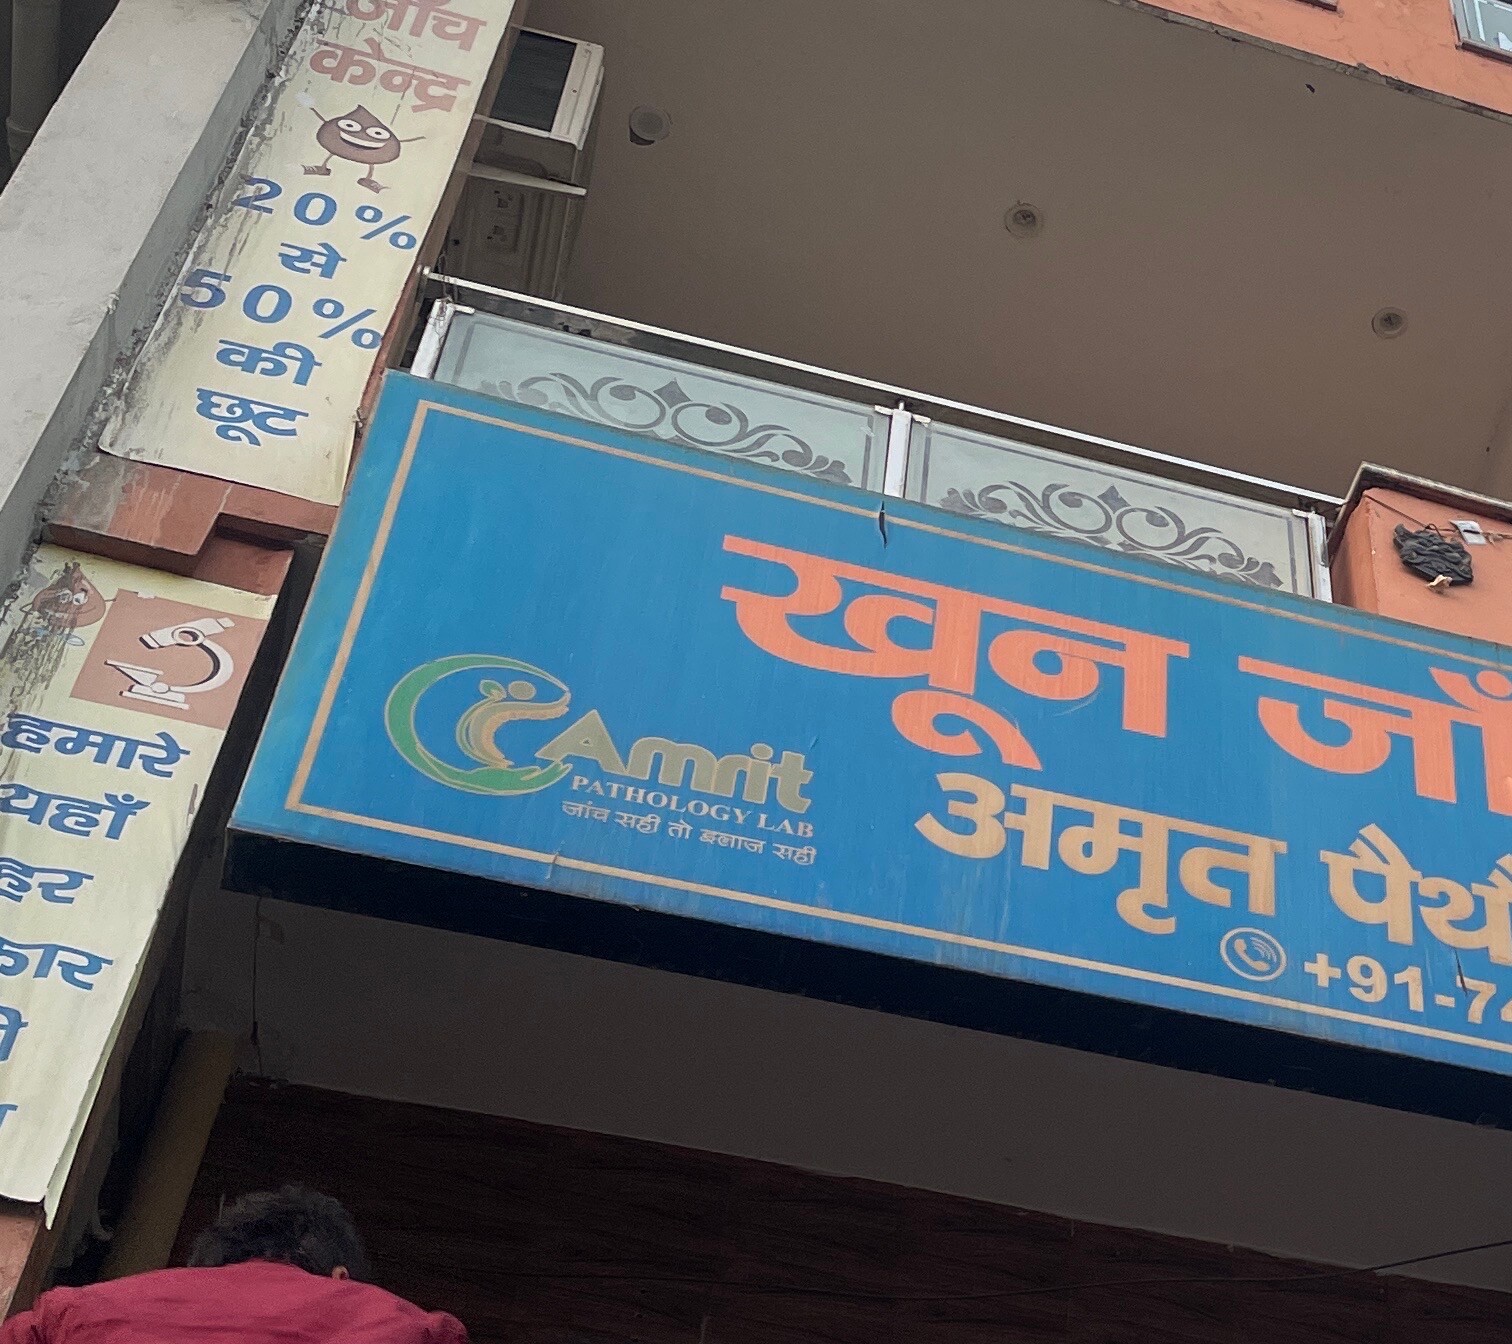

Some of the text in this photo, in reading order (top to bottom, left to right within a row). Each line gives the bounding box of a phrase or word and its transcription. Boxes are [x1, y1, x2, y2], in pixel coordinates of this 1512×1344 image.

[310, 38, 471, 113] केन्द्र
[232, 177, 417, 249] 20%
[278, 242, 347, 279] से
[180, 268, 382, 349] 50%
[216, 339, 322, 386] की
[196, 388, 309, 446] छूट
[722, 534, 1190, 770] खून
[1, 713, 190, 778] हमारे
[535, 709, 813, 814] Amrit
[0, 783, 151, 840] यहाँ
[571, 775, 814, 838] PATHOLOGY LAB
[614, 811, 661, 834] सही
[668, 819, 693, 840] तो
[771, 843, 817, 866] सही
[914, 772, 1287, 936] अमृत
